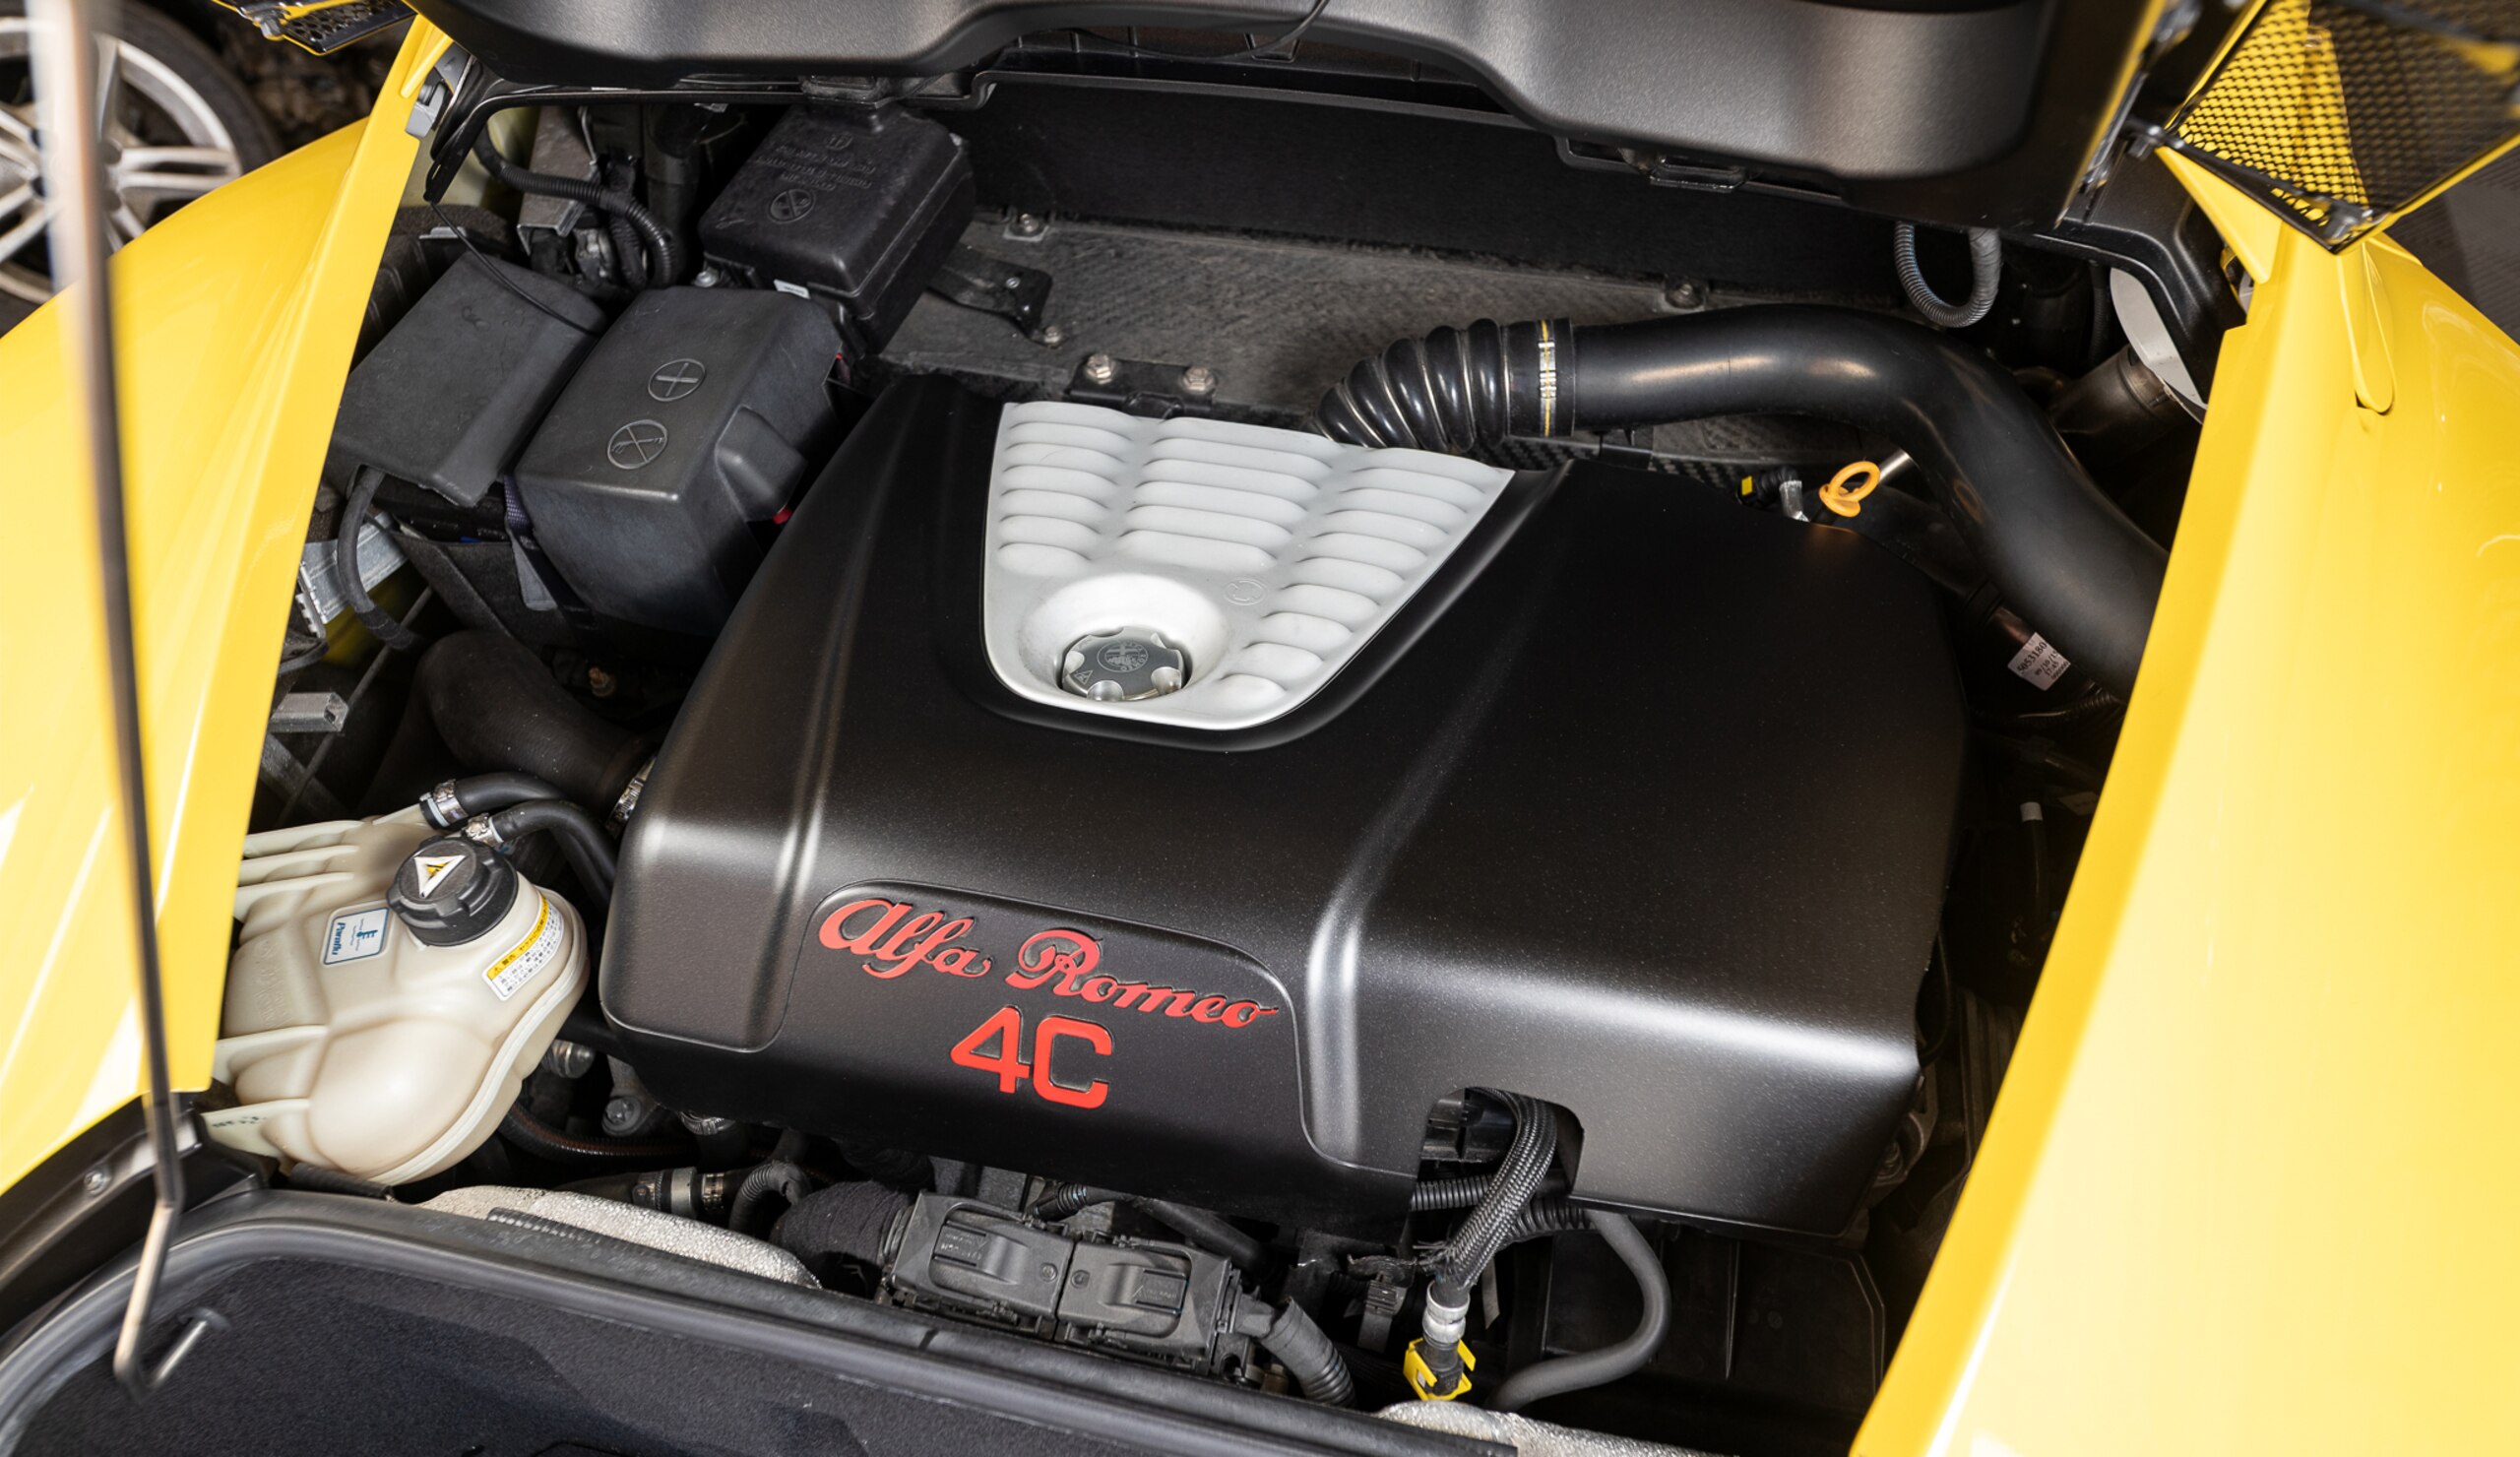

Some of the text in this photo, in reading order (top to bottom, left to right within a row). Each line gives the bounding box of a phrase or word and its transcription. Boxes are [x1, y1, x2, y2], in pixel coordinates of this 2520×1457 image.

[819, 899, 1279, 1028] Alfa Romeo
[950, 1006, 1112, 1109] 4C
